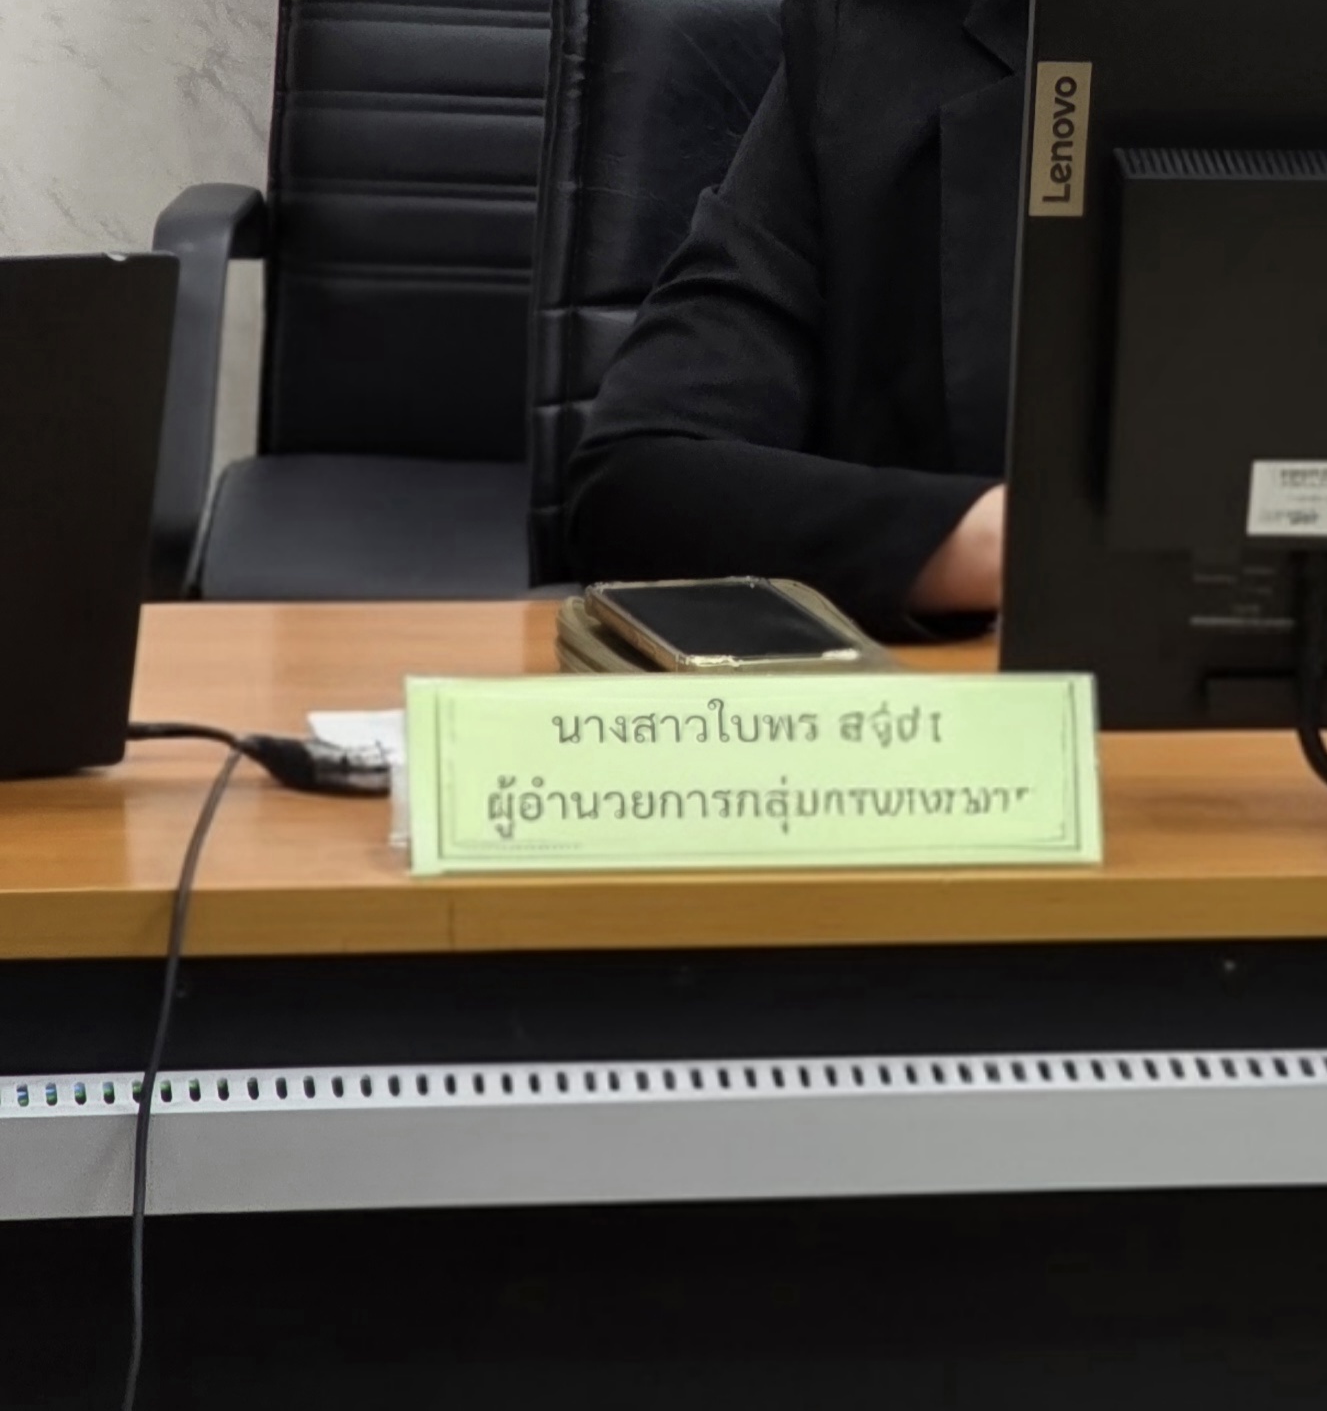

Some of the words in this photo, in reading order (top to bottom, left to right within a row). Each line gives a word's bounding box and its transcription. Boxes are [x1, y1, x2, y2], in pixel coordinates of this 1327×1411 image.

[1042, 75, 1078, 203] Lenovo
[551, 697, 819, 744] นางสาวใบพร
